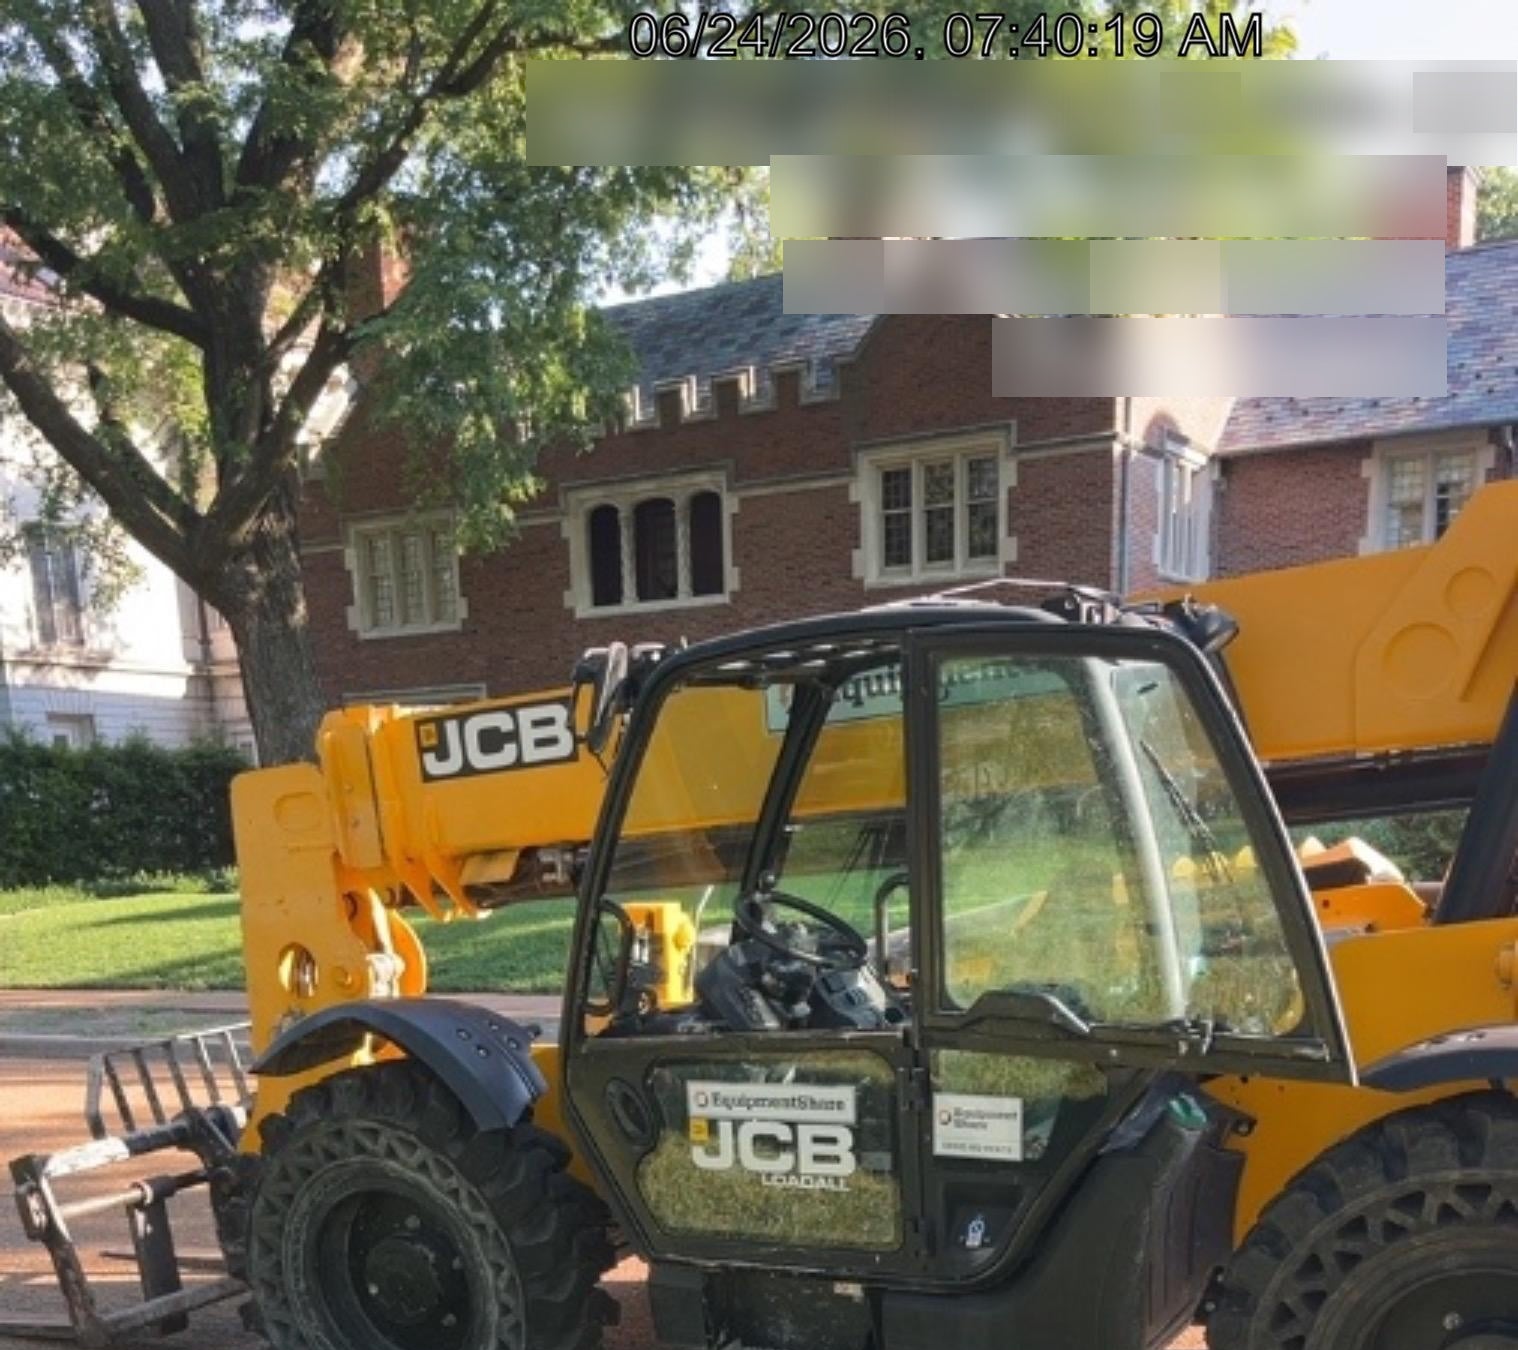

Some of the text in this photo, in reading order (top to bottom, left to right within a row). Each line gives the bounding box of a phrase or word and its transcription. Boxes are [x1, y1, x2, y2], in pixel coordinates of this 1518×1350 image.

[421, 704, 574, 776] JCB
[713, 1091, 846, 1112] EquipmentShare
[691, 1119, 857, 1176] JCB
[762, 1174, 851, 1192] LOADALL
